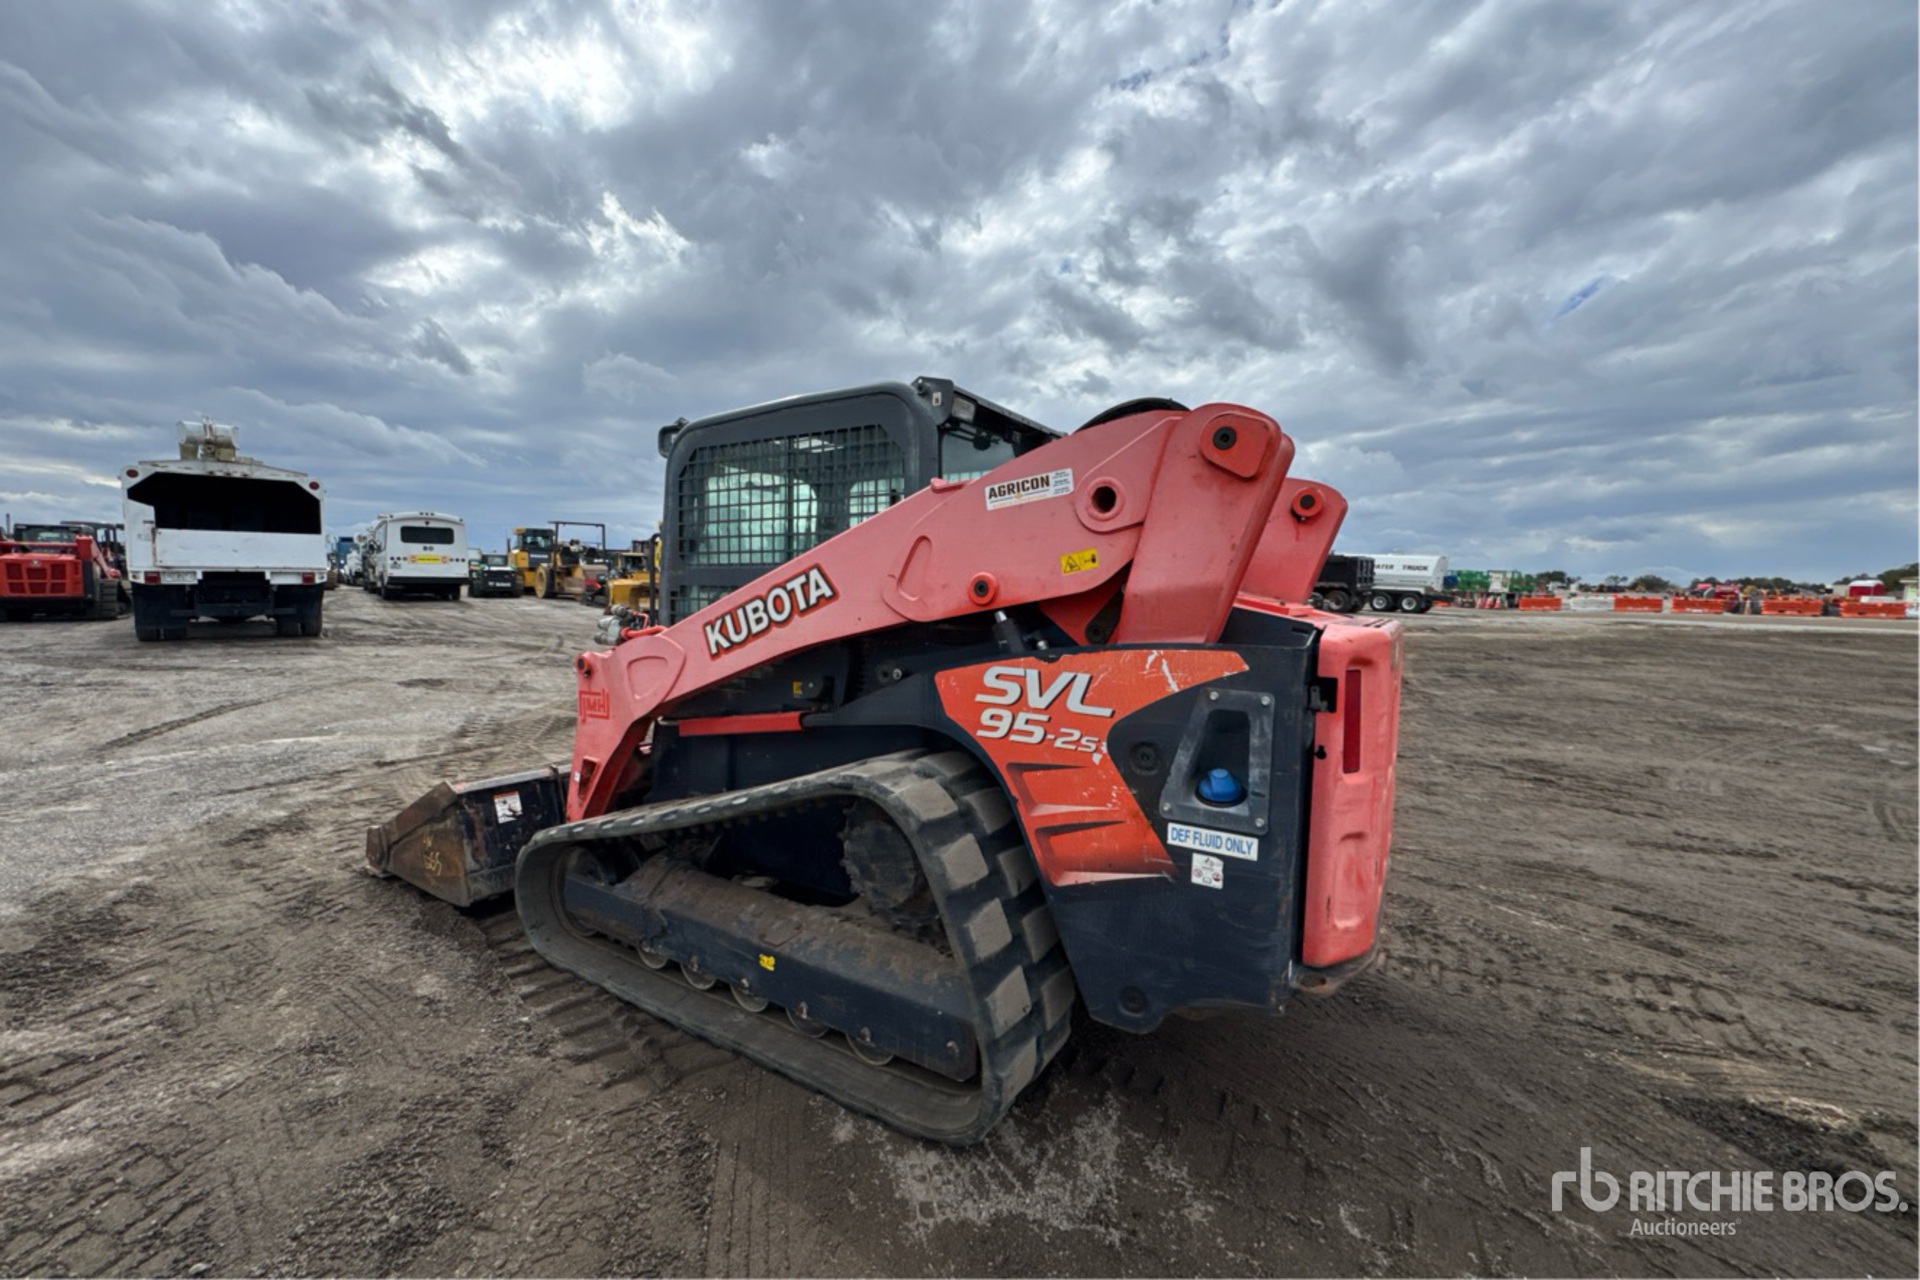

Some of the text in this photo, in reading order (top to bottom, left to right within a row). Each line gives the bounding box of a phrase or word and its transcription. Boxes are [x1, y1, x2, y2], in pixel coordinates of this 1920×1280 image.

[988, 474, 1050, 500] AGRICON
[704, 567, 834, 655] KUBOTA
[974, 665, 1115, 718] SVL
[1171, 827, 1255, 856] DEF FLUID ONLY
